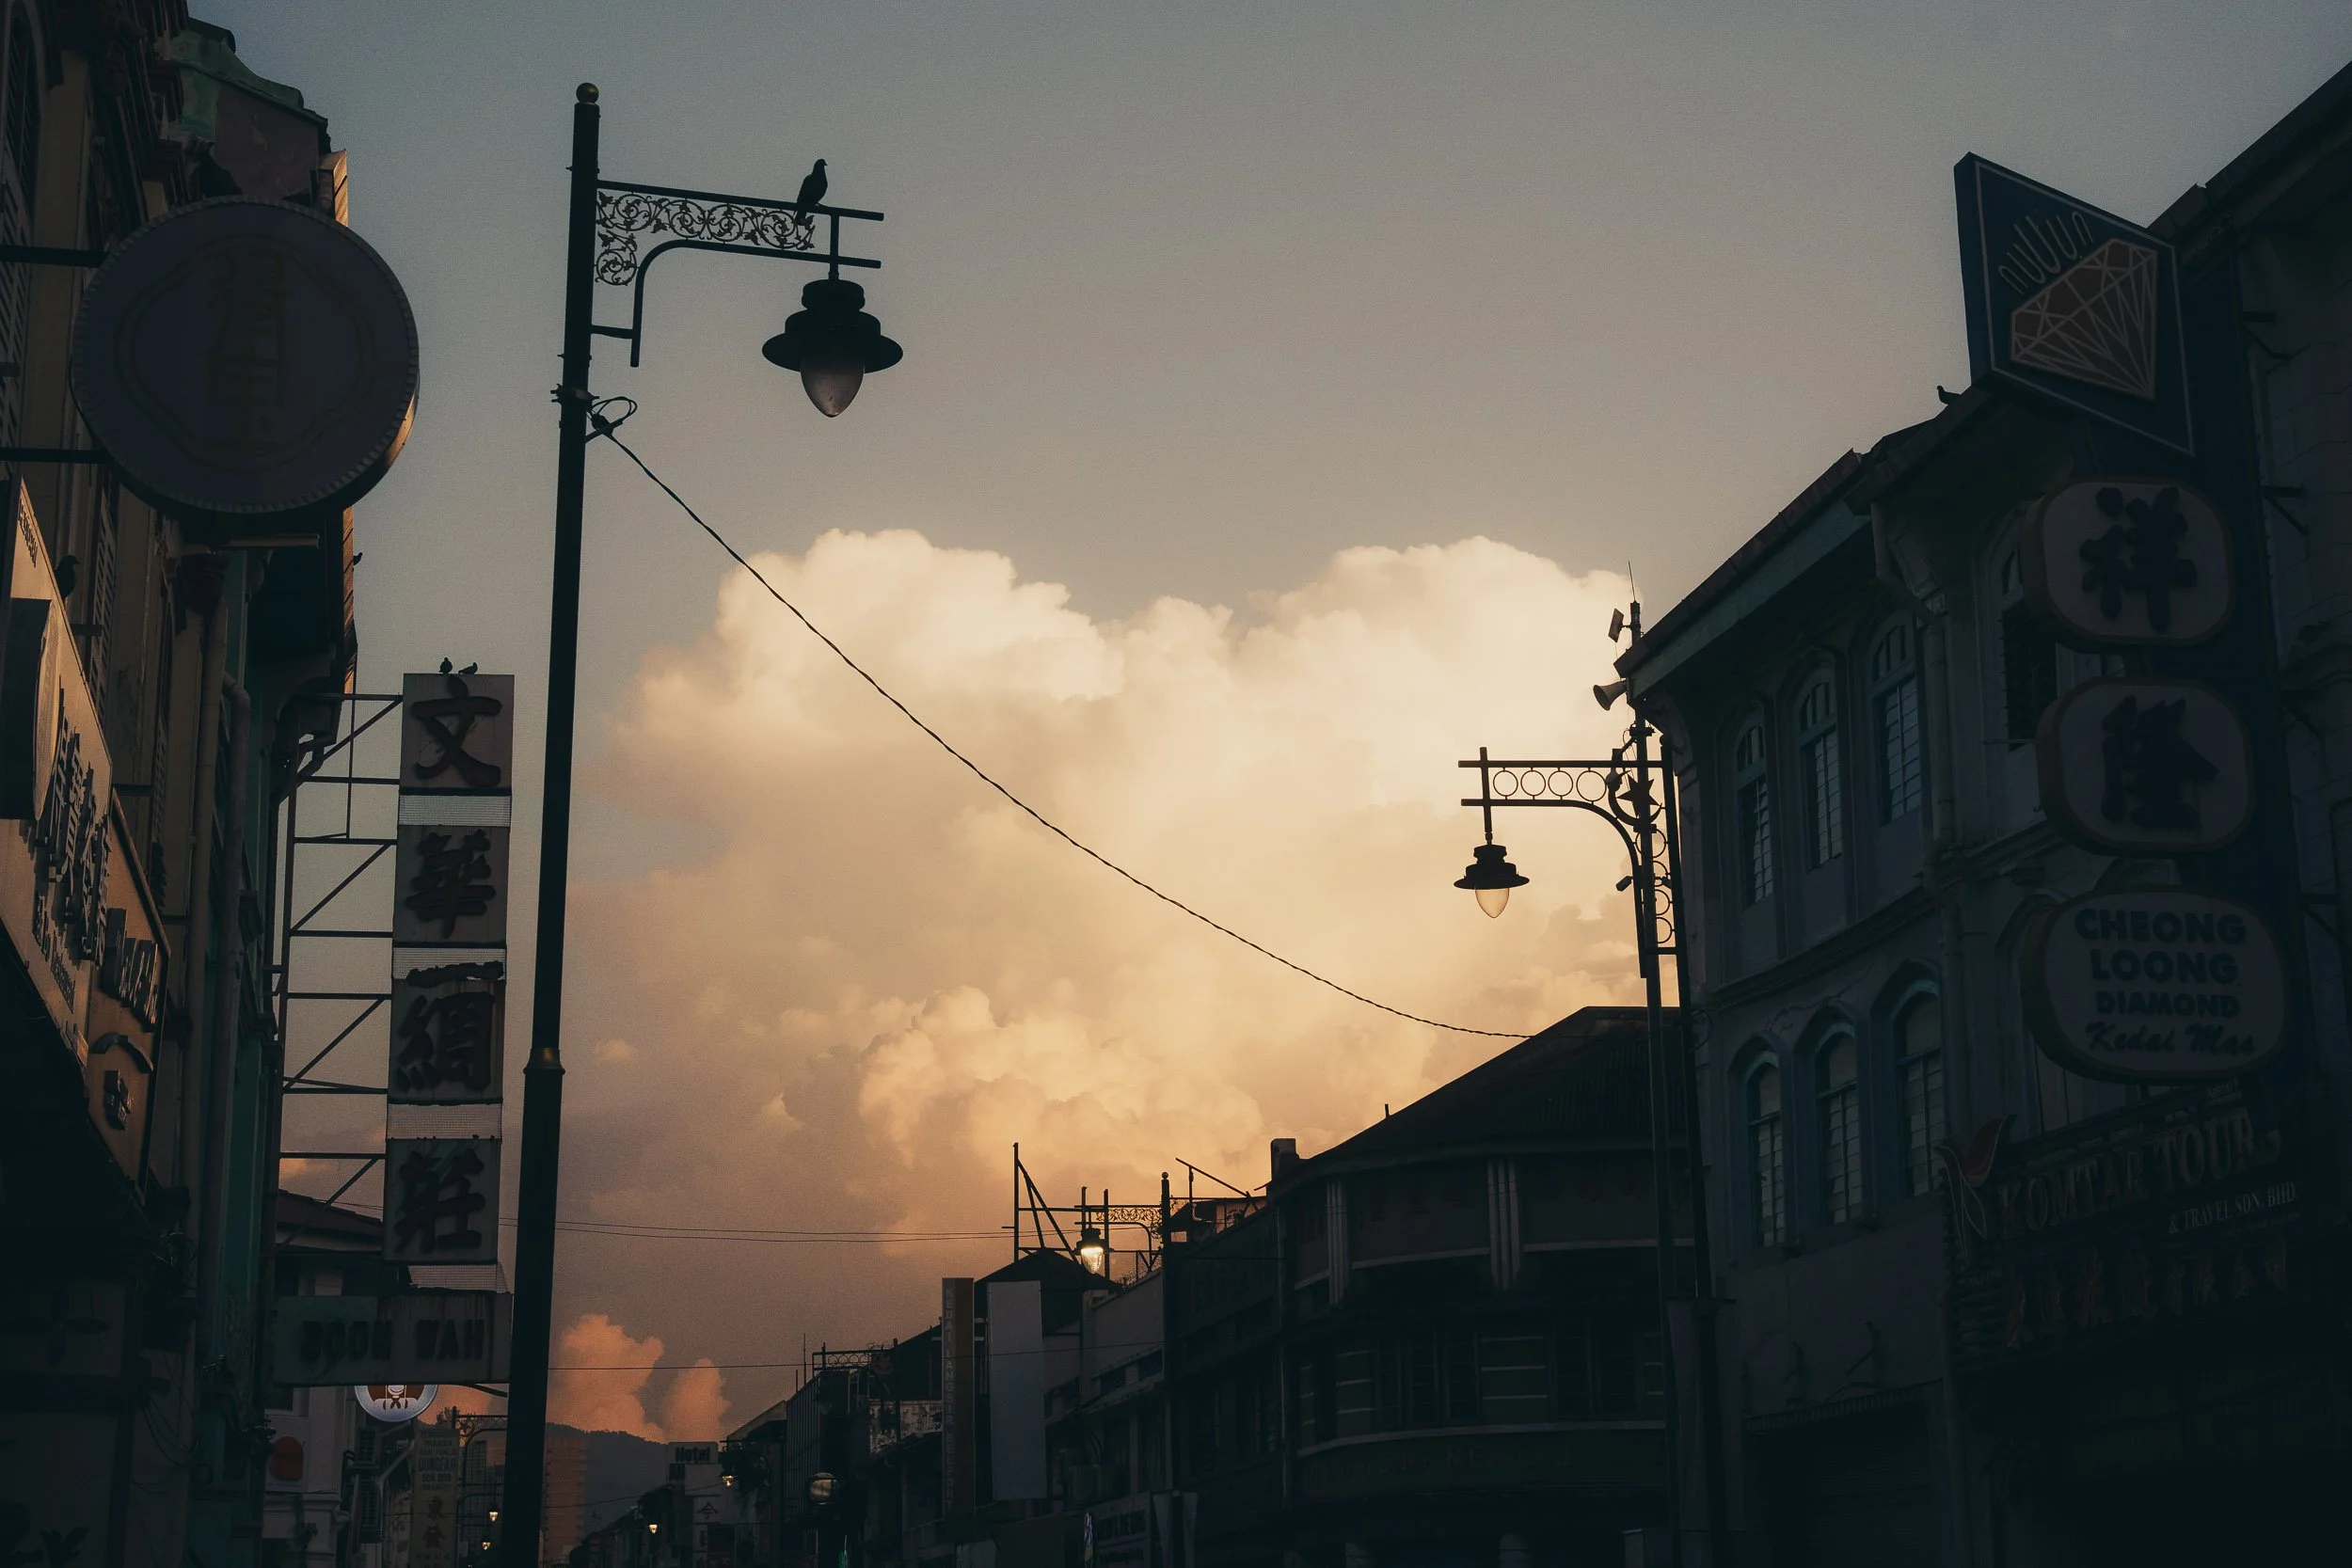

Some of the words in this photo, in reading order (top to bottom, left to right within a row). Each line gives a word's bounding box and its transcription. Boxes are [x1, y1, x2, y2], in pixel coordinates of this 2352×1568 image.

[2074, 907, 2247, 944] CHEONG
[2090, 948, 2238, 984] LOONG
[2094, 990, 2241, 1018] DIAMOND
[2083, 1022, 2175, 1053] Kedai
[2186, 1022, 2257, 1054] Mas
[1998, 1147, 2150, 1240] KOMTAR
[2168, 1213, 2180, 1234] &
[2183, 1199, 2233, 1229] TRAVEL
[945, 1290, 956, 1341] KEDAI
[945, 1349, 956, 1425] LANGSIR
[675, 1446, 712, 1463] Hotel
